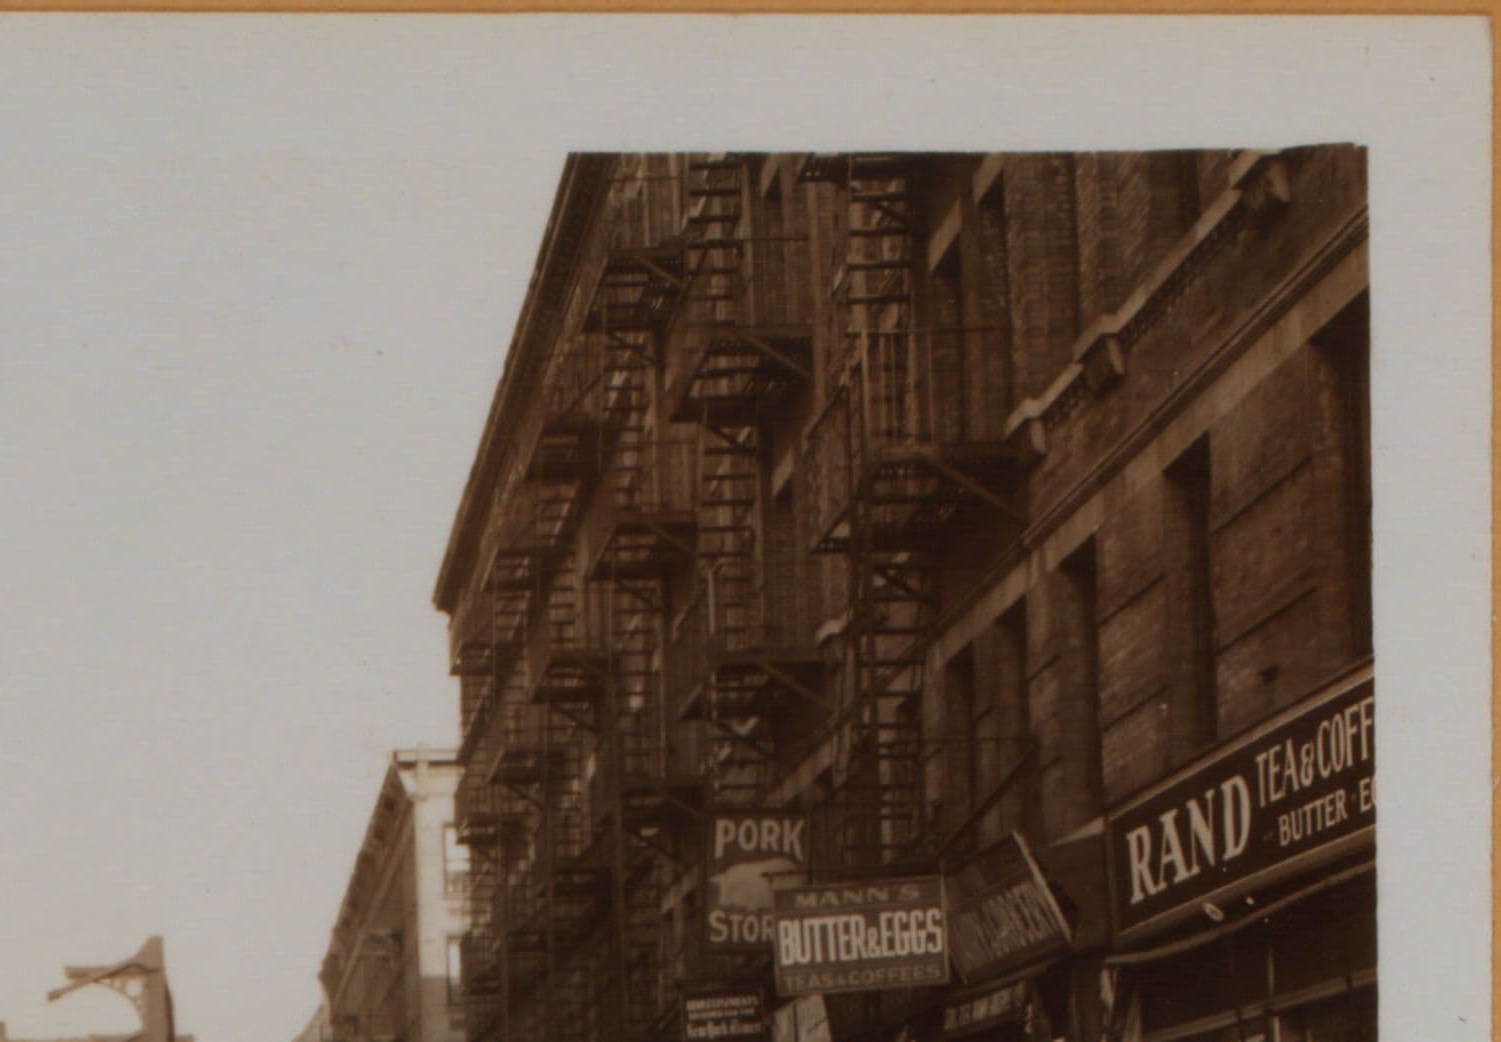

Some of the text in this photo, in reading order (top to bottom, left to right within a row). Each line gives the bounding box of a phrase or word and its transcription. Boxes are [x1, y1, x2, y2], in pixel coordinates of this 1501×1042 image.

[713, 817, 805, 861] PORK
[1126, 774, 1252, 905] RAND
[1278, 788, 1349, 848] BUTTER
